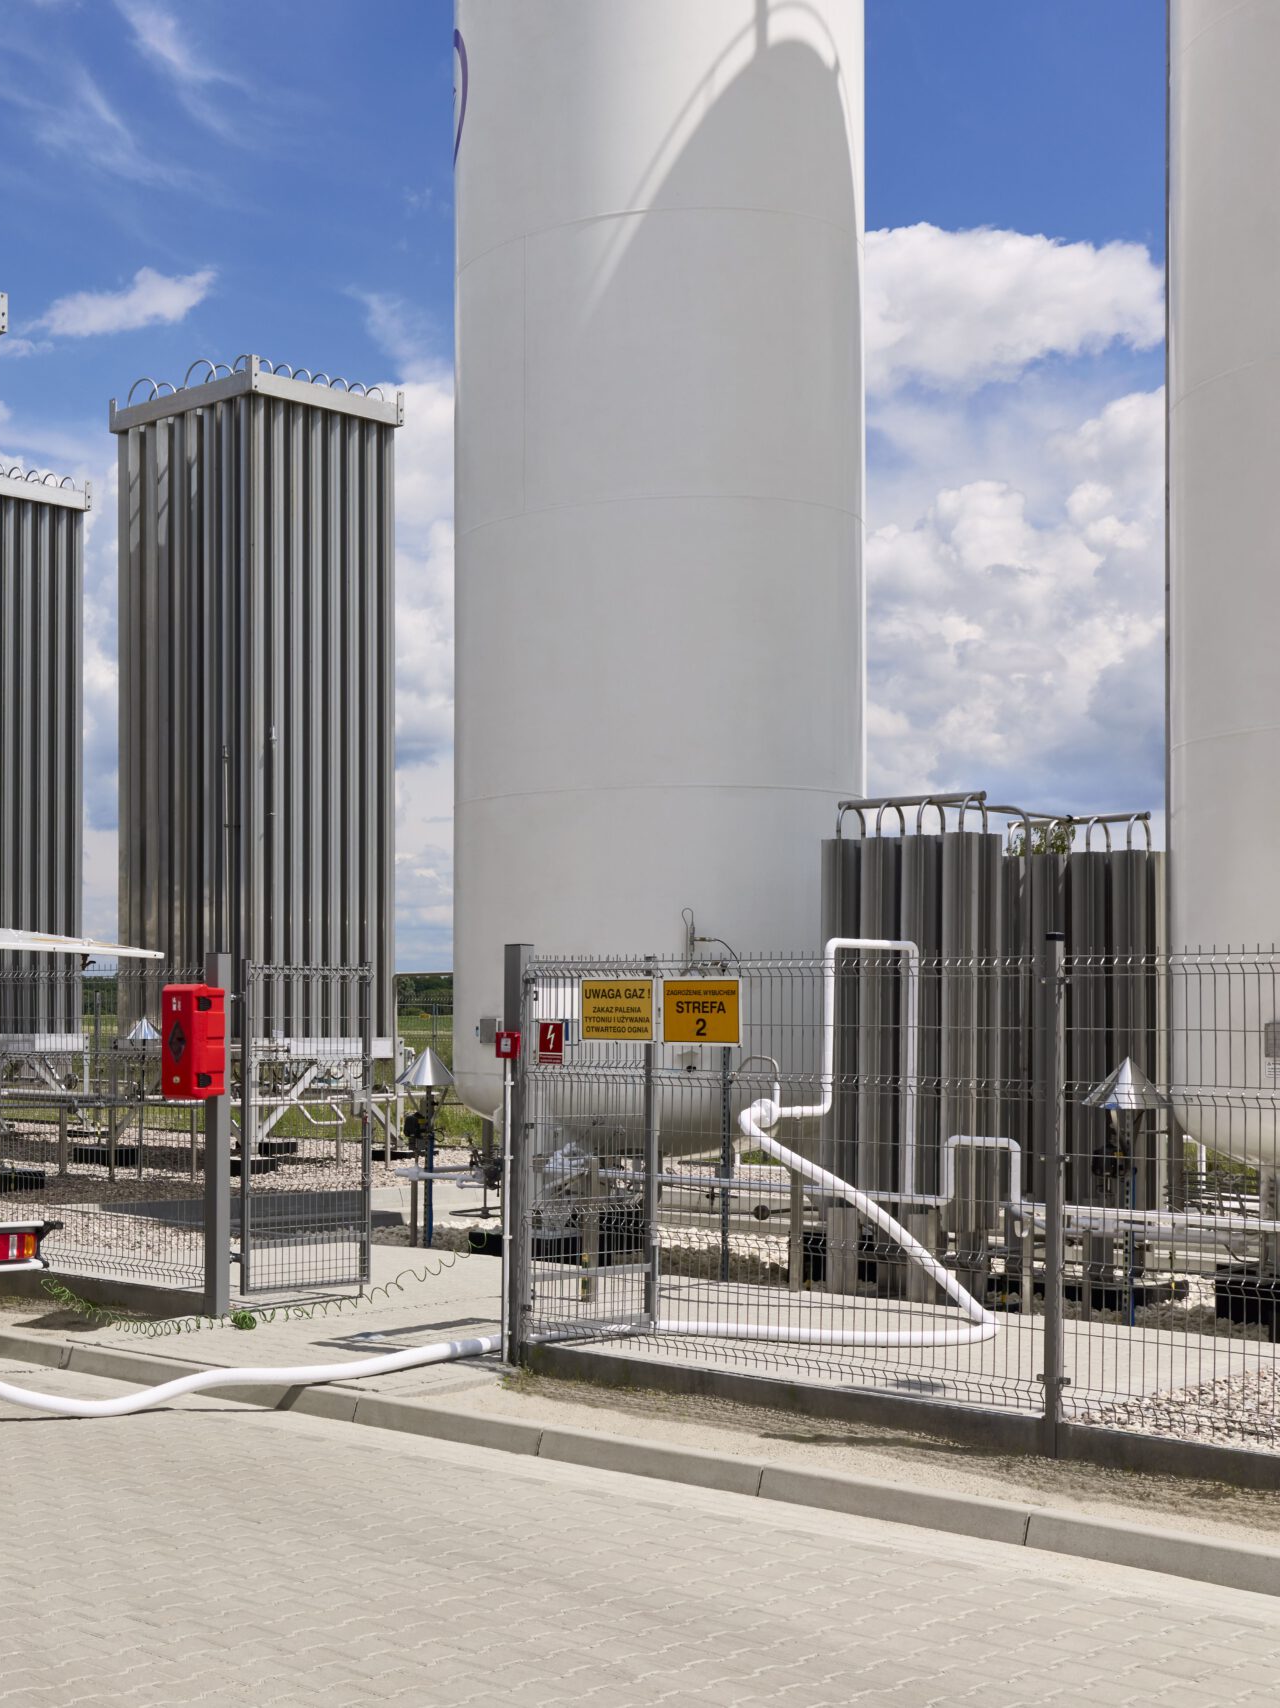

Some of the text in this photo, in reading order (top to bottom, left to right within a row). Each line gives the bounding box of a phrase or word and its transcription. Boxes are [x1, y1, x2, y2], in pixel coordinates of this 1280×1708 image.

[584, 988, 622, 999] UWAGA
[624, 988, 645, 999] GAZ
[676, 1001, 726, 1014] STREFA
[695, 1018, 707, 1037] 2
